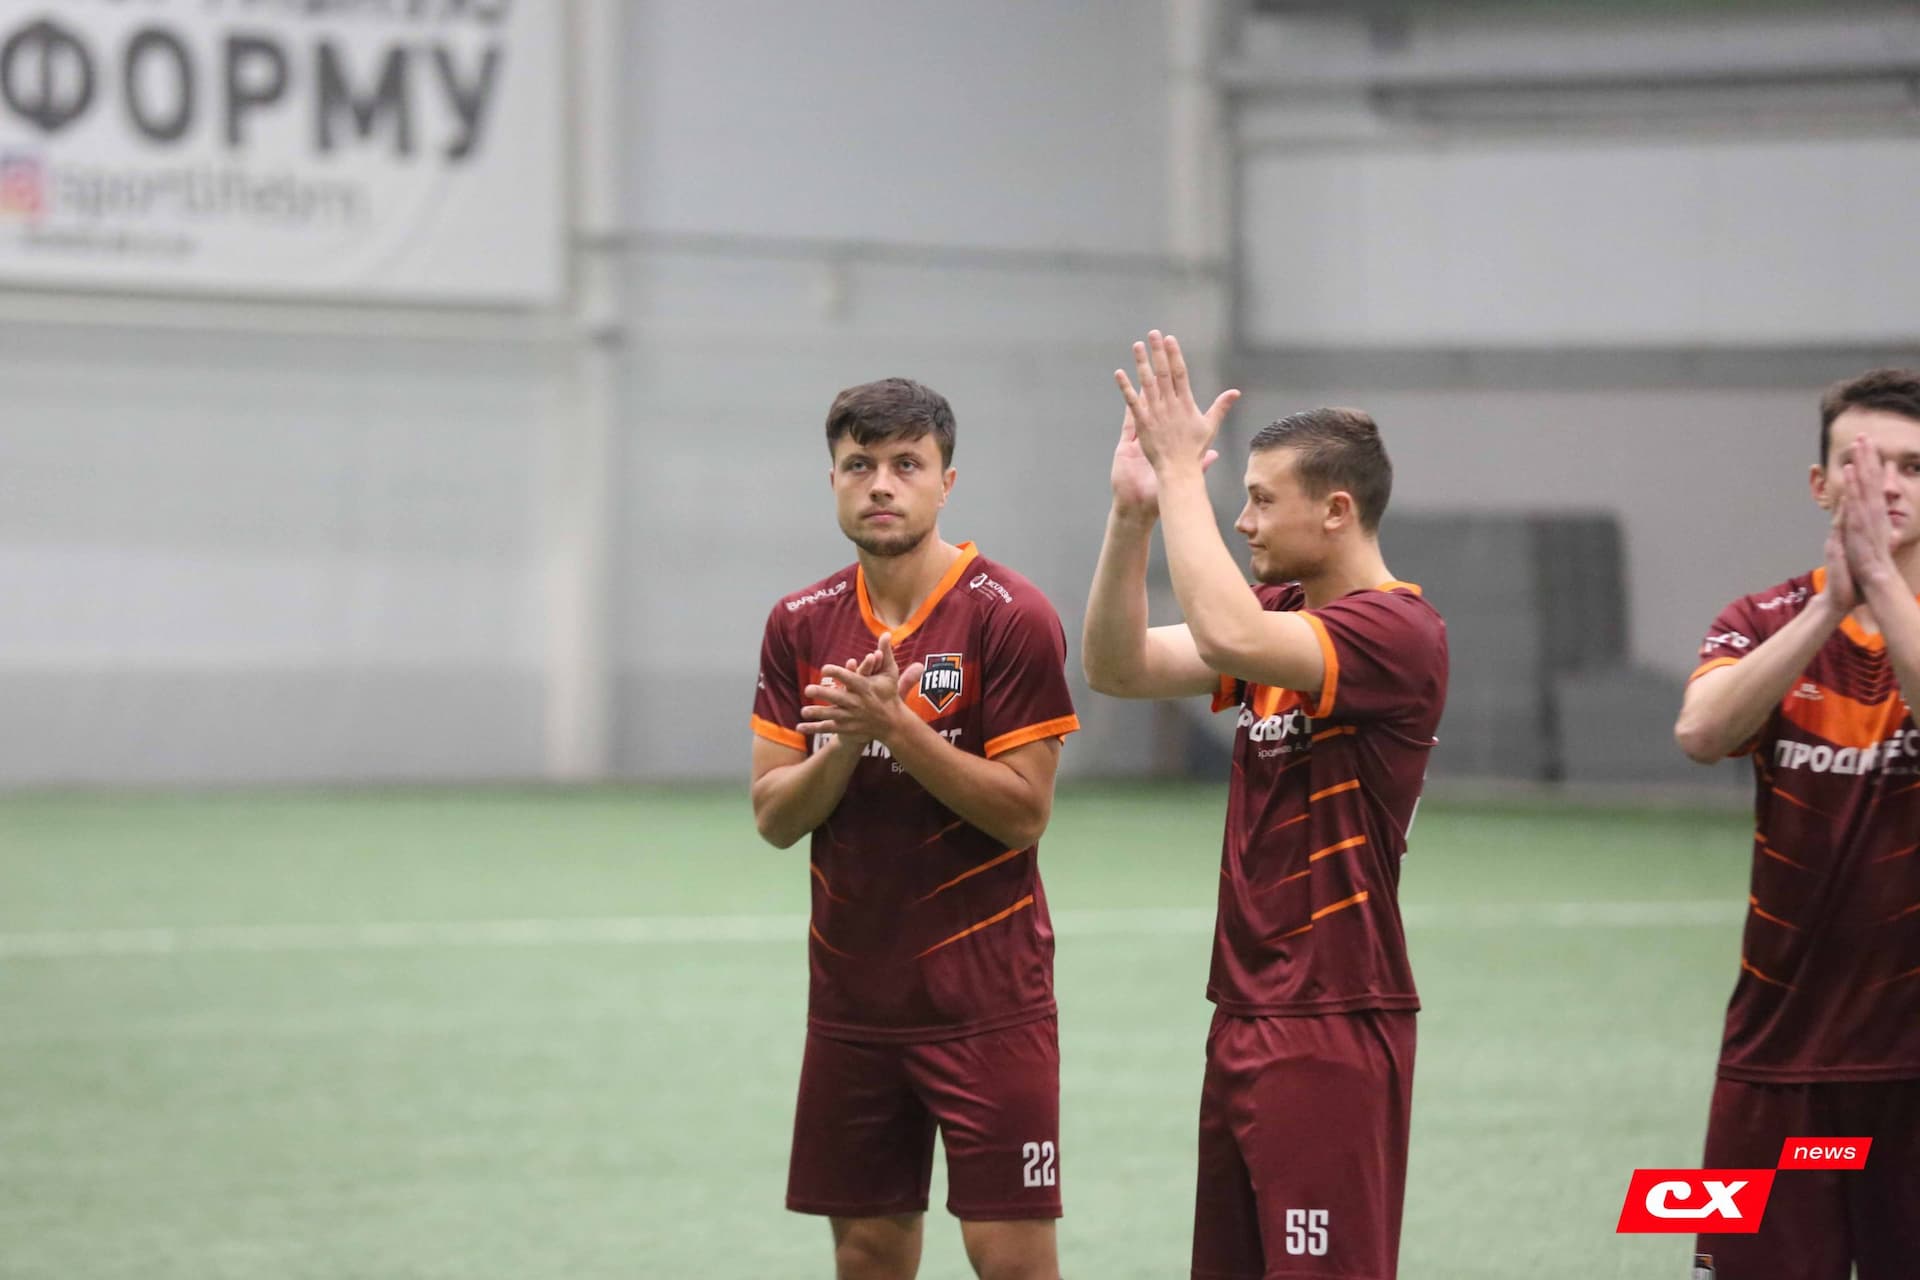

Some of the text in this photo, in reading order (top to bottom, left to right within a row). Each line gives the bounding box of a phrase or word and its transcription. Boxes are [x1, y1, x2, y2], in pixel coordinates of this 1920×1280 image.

[0, 17, 503, 163] ФОРМУ
[925, 669, 960, 690] ТЕМП
[1022, 1140, 1056, 1188] 22
[1285, 1208, 1329, 1256] 55
